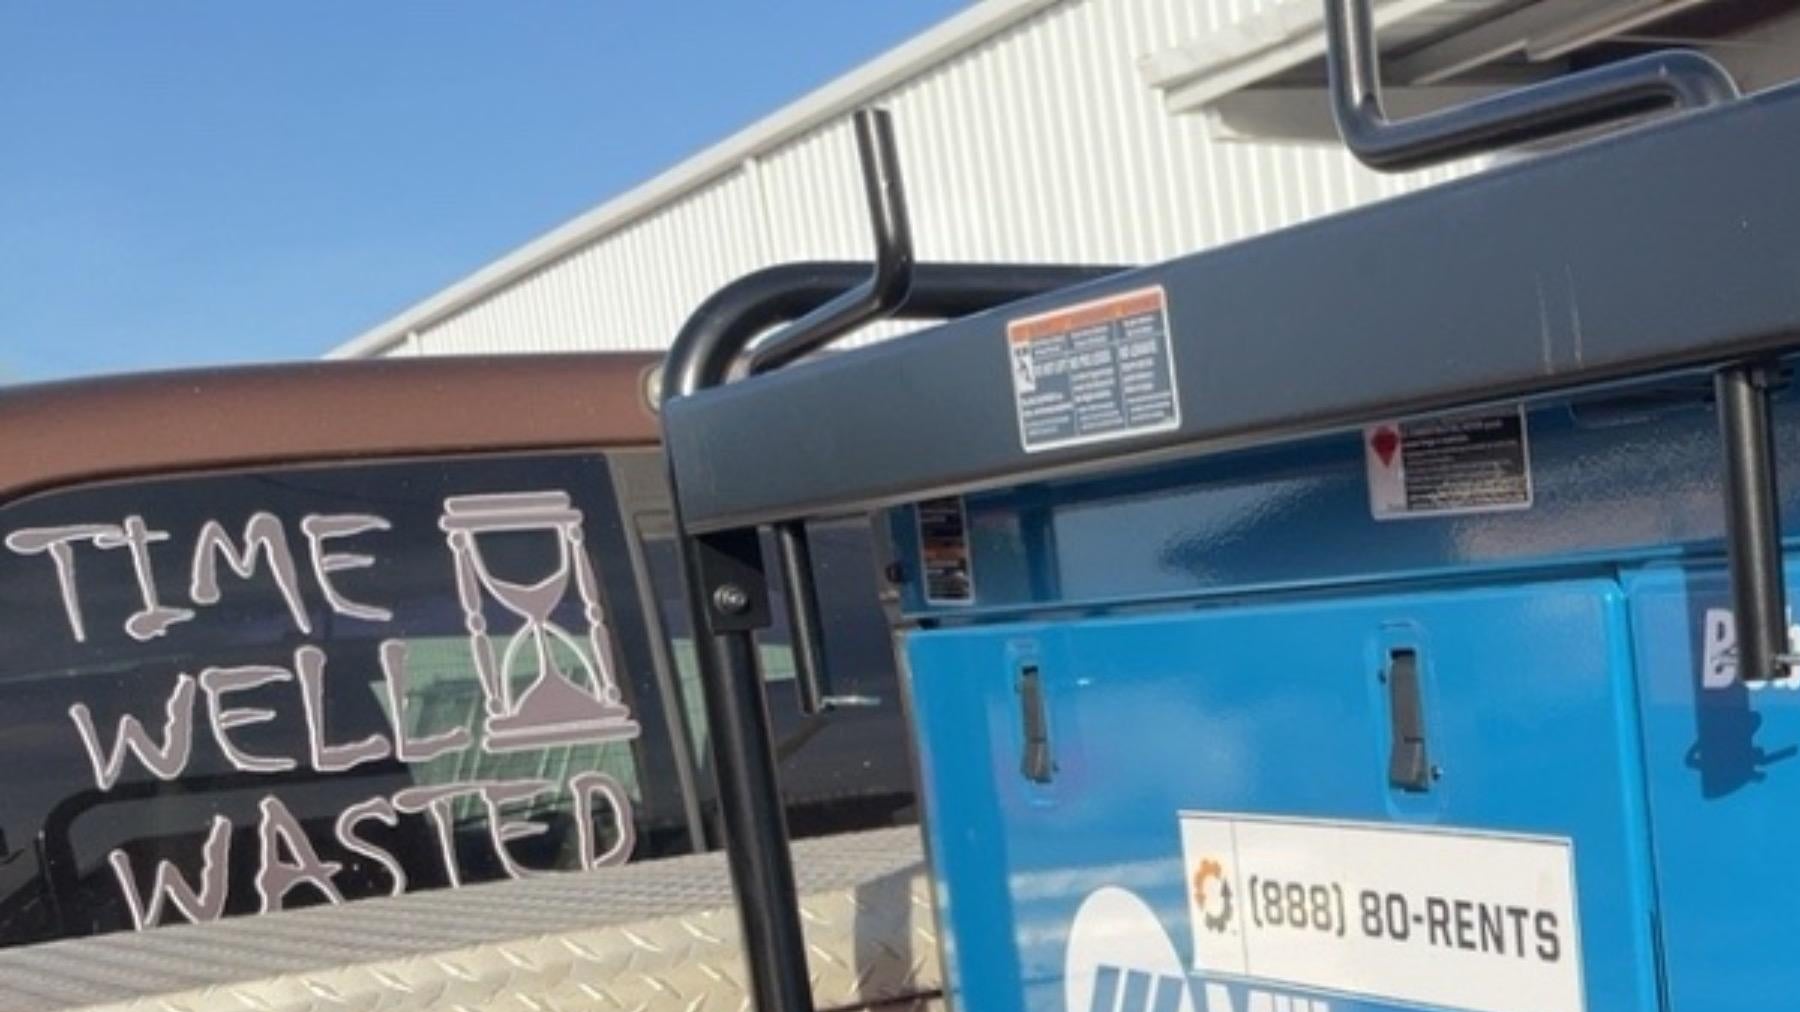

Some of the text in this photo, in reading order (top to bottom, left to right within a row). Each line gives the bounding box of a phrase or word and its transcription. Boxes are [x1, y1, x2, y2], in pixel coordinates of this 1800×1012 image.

[5, 512, 392, 643] TIME
[68, 638, 470, 790] WELL
[108, 770, 636, 931] WASTED
[1249, 875, 1560, 963] (888) 80-RENTS
